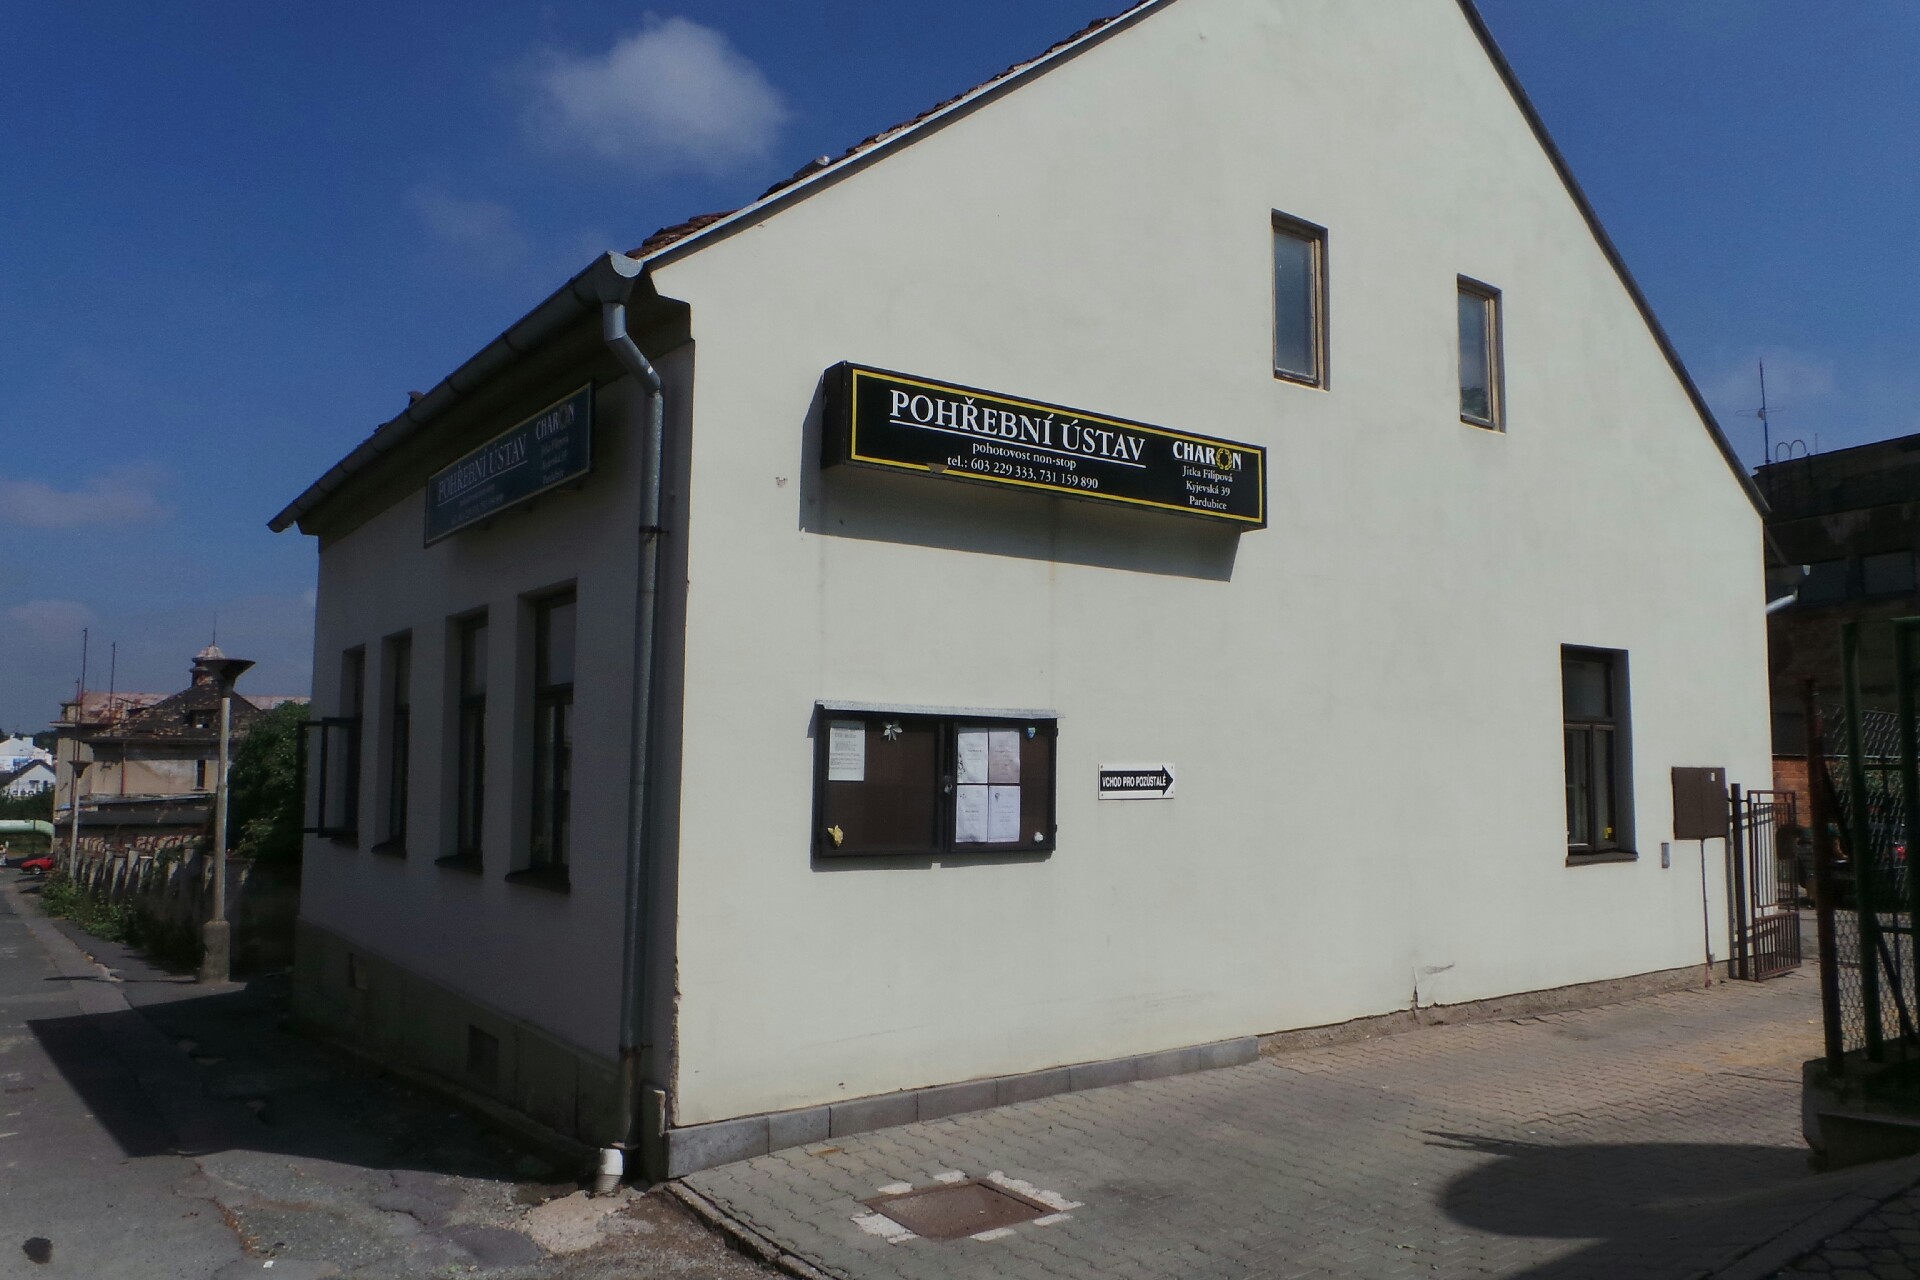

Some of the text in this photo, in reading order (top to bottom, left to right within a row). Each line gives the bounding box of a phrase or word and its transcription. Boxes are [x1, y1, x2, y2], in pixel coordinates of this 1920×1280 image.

[890, 390, 1146, 461] POHŘEBNÍ ÚSTAV
[972, 442, 1077, 471] pohotovost non-stop
[1172, 440, 1242, 471] CHARON
[947, 455, 1099, 489] tel.: 603 229 333, 731 159 890
[1182, 465, 1233, 483] Jitka Filipová
[1186, 480, 1231, 497] Kyjevská 39
[1189, 495, 1228, 510] Pardubice
[1102, 776, 1121, 788] VCHOD
[1122, 776, 1135, 787] PRO
